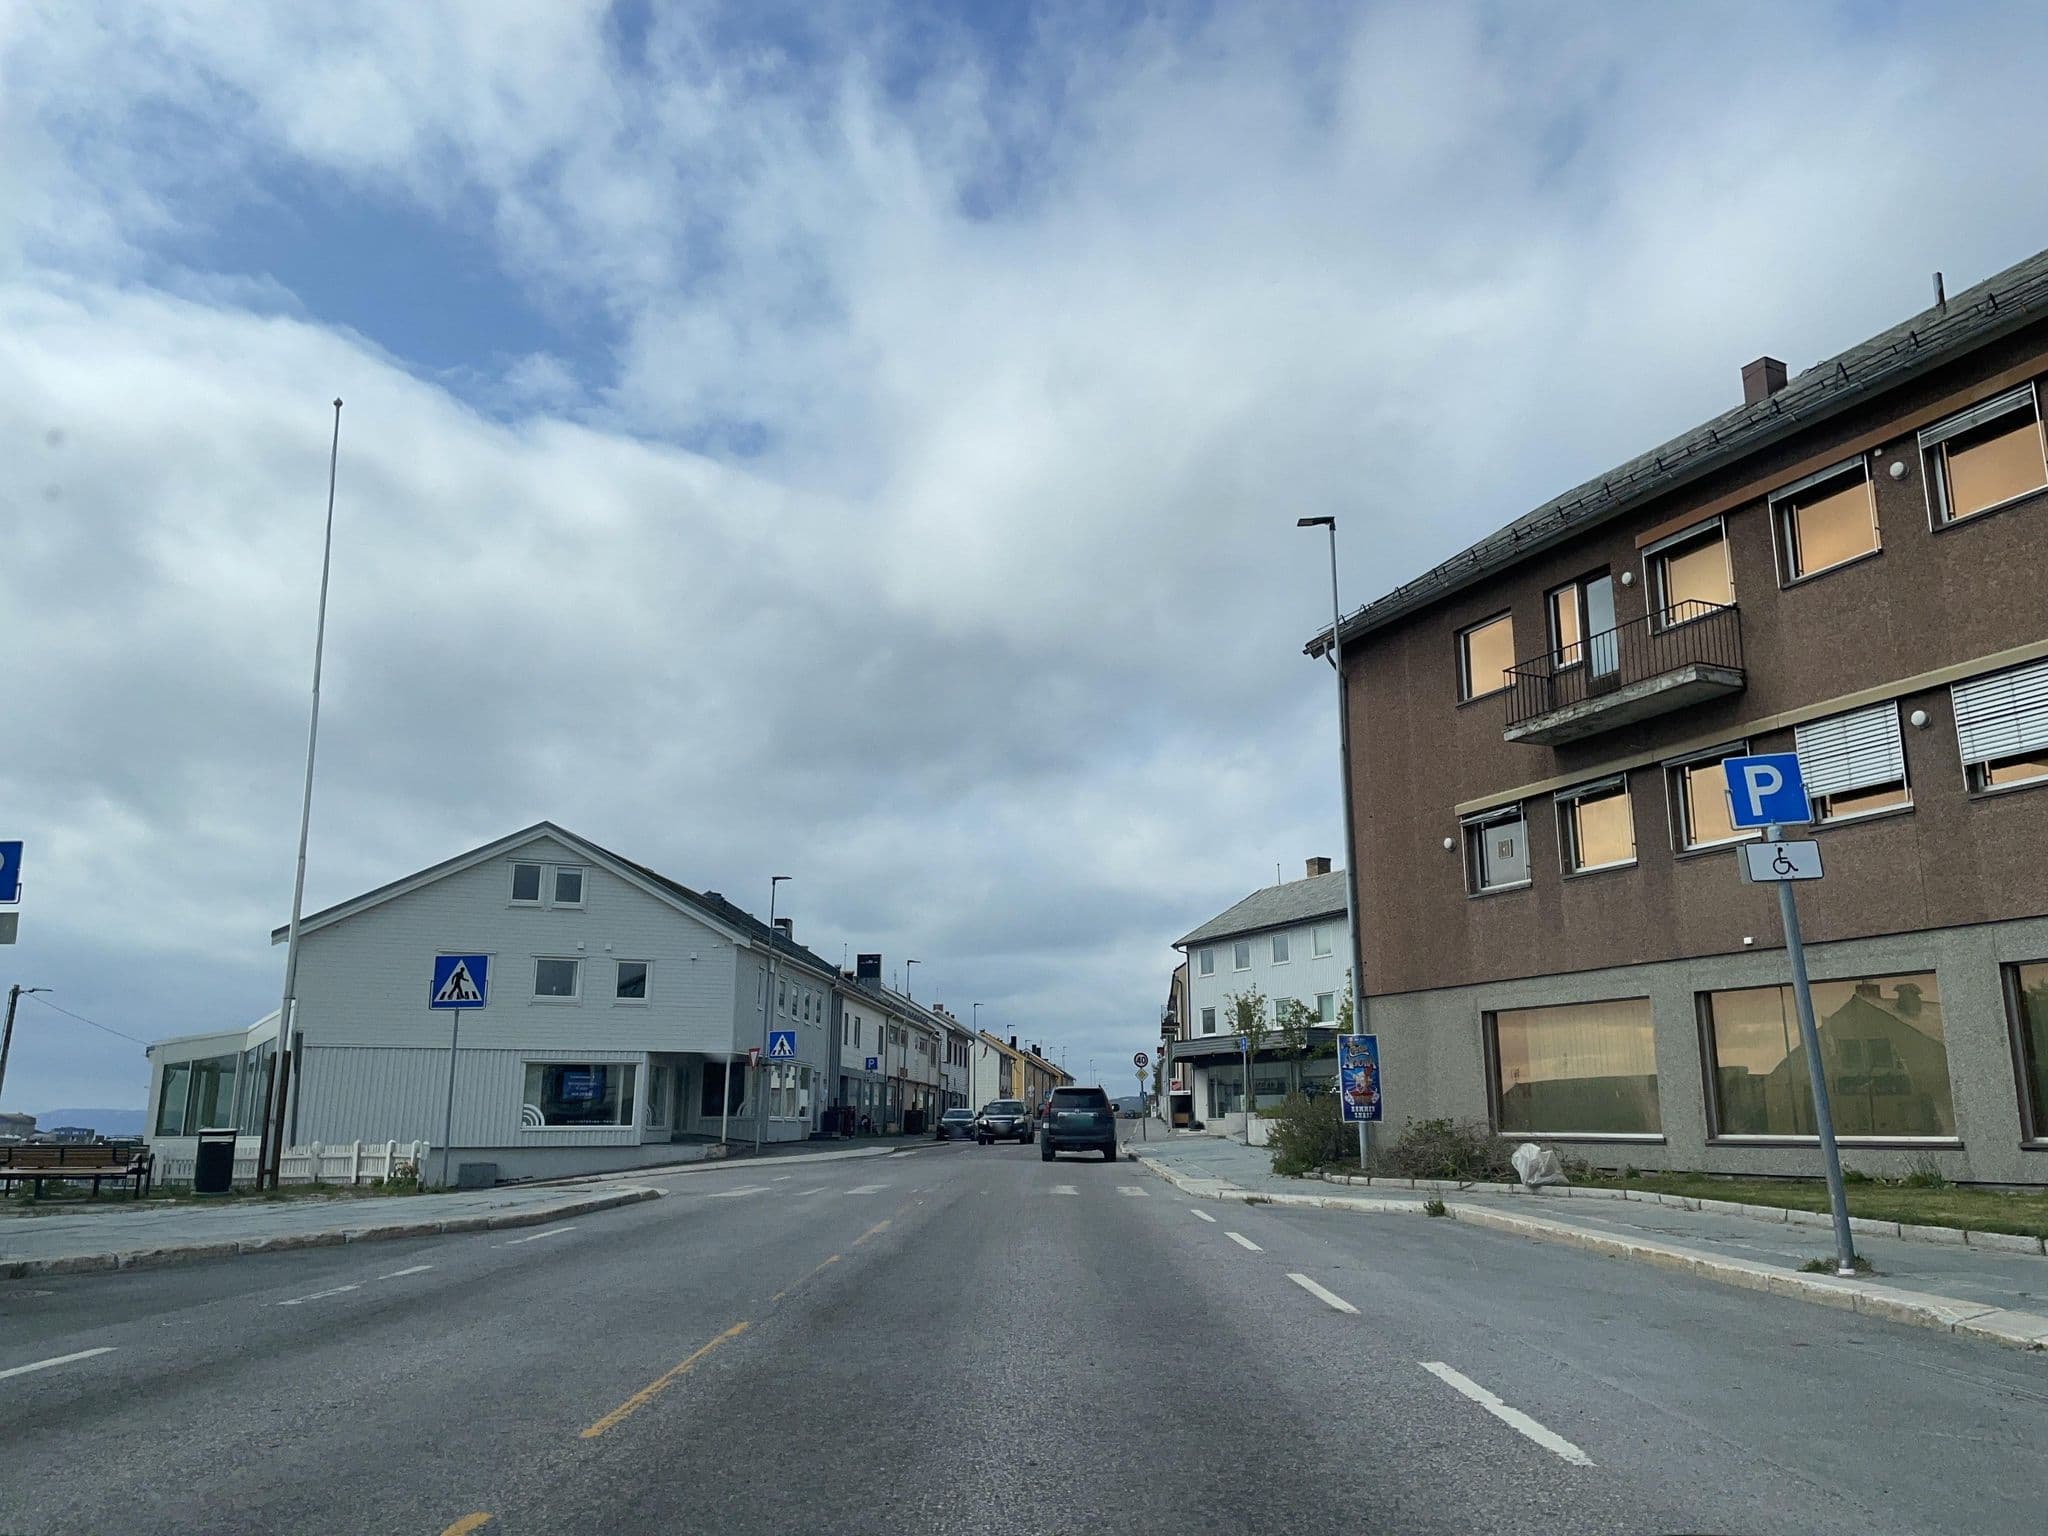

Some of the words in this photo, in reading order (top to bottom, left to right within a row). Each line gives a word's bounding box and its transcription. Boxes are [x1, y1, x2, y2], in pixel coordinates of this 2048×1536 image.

[1743, 764, 1783, 817] P
[868, 1058, 875, 1068] P
[1136, 1056, 1146, 1065] 40
